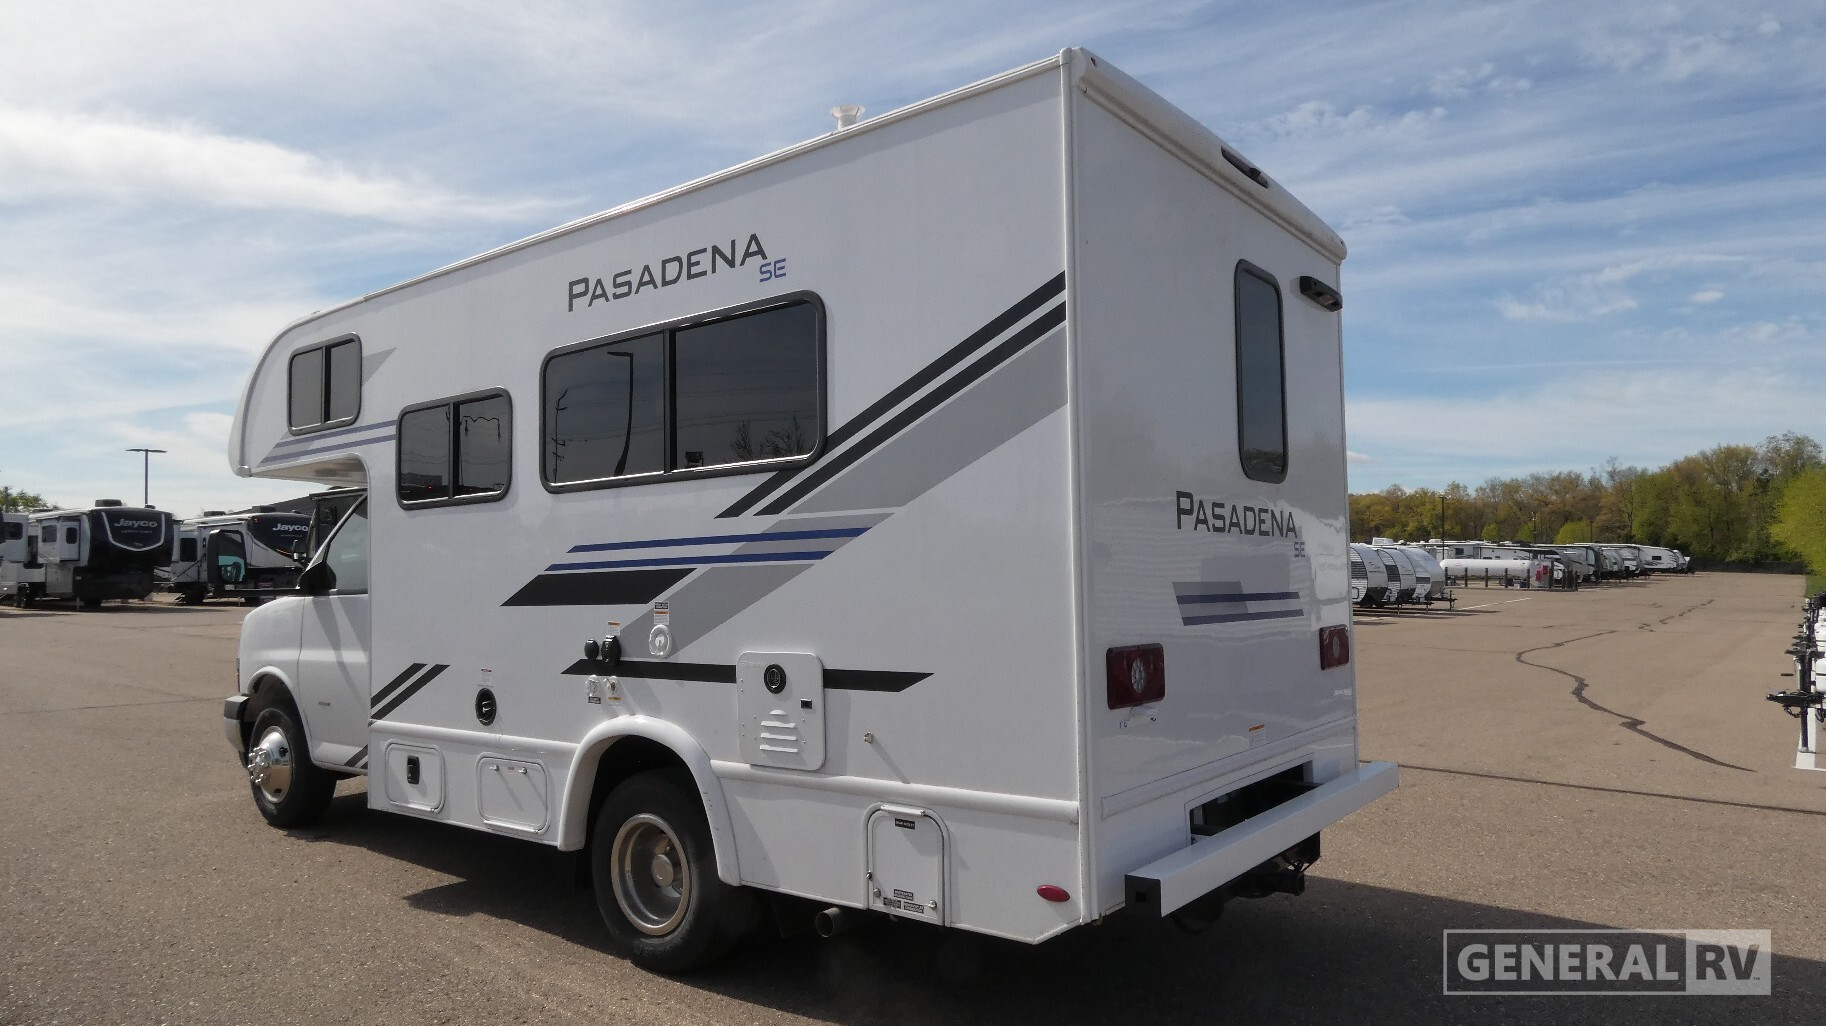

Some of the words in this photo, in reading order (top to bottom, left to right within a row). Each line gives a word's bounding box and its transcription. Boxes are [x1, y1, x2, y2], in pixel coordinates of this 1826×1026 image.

[568, 233, 768, 313] PASADENA
[759, 258, 787, 283] SE
[113, 518, 158, 528] Jayco
[1176, 490, 1298, 539] PASADENA
[272, 523, 309, 532] Jayco
[1293, 541, 1306, 558] SE
